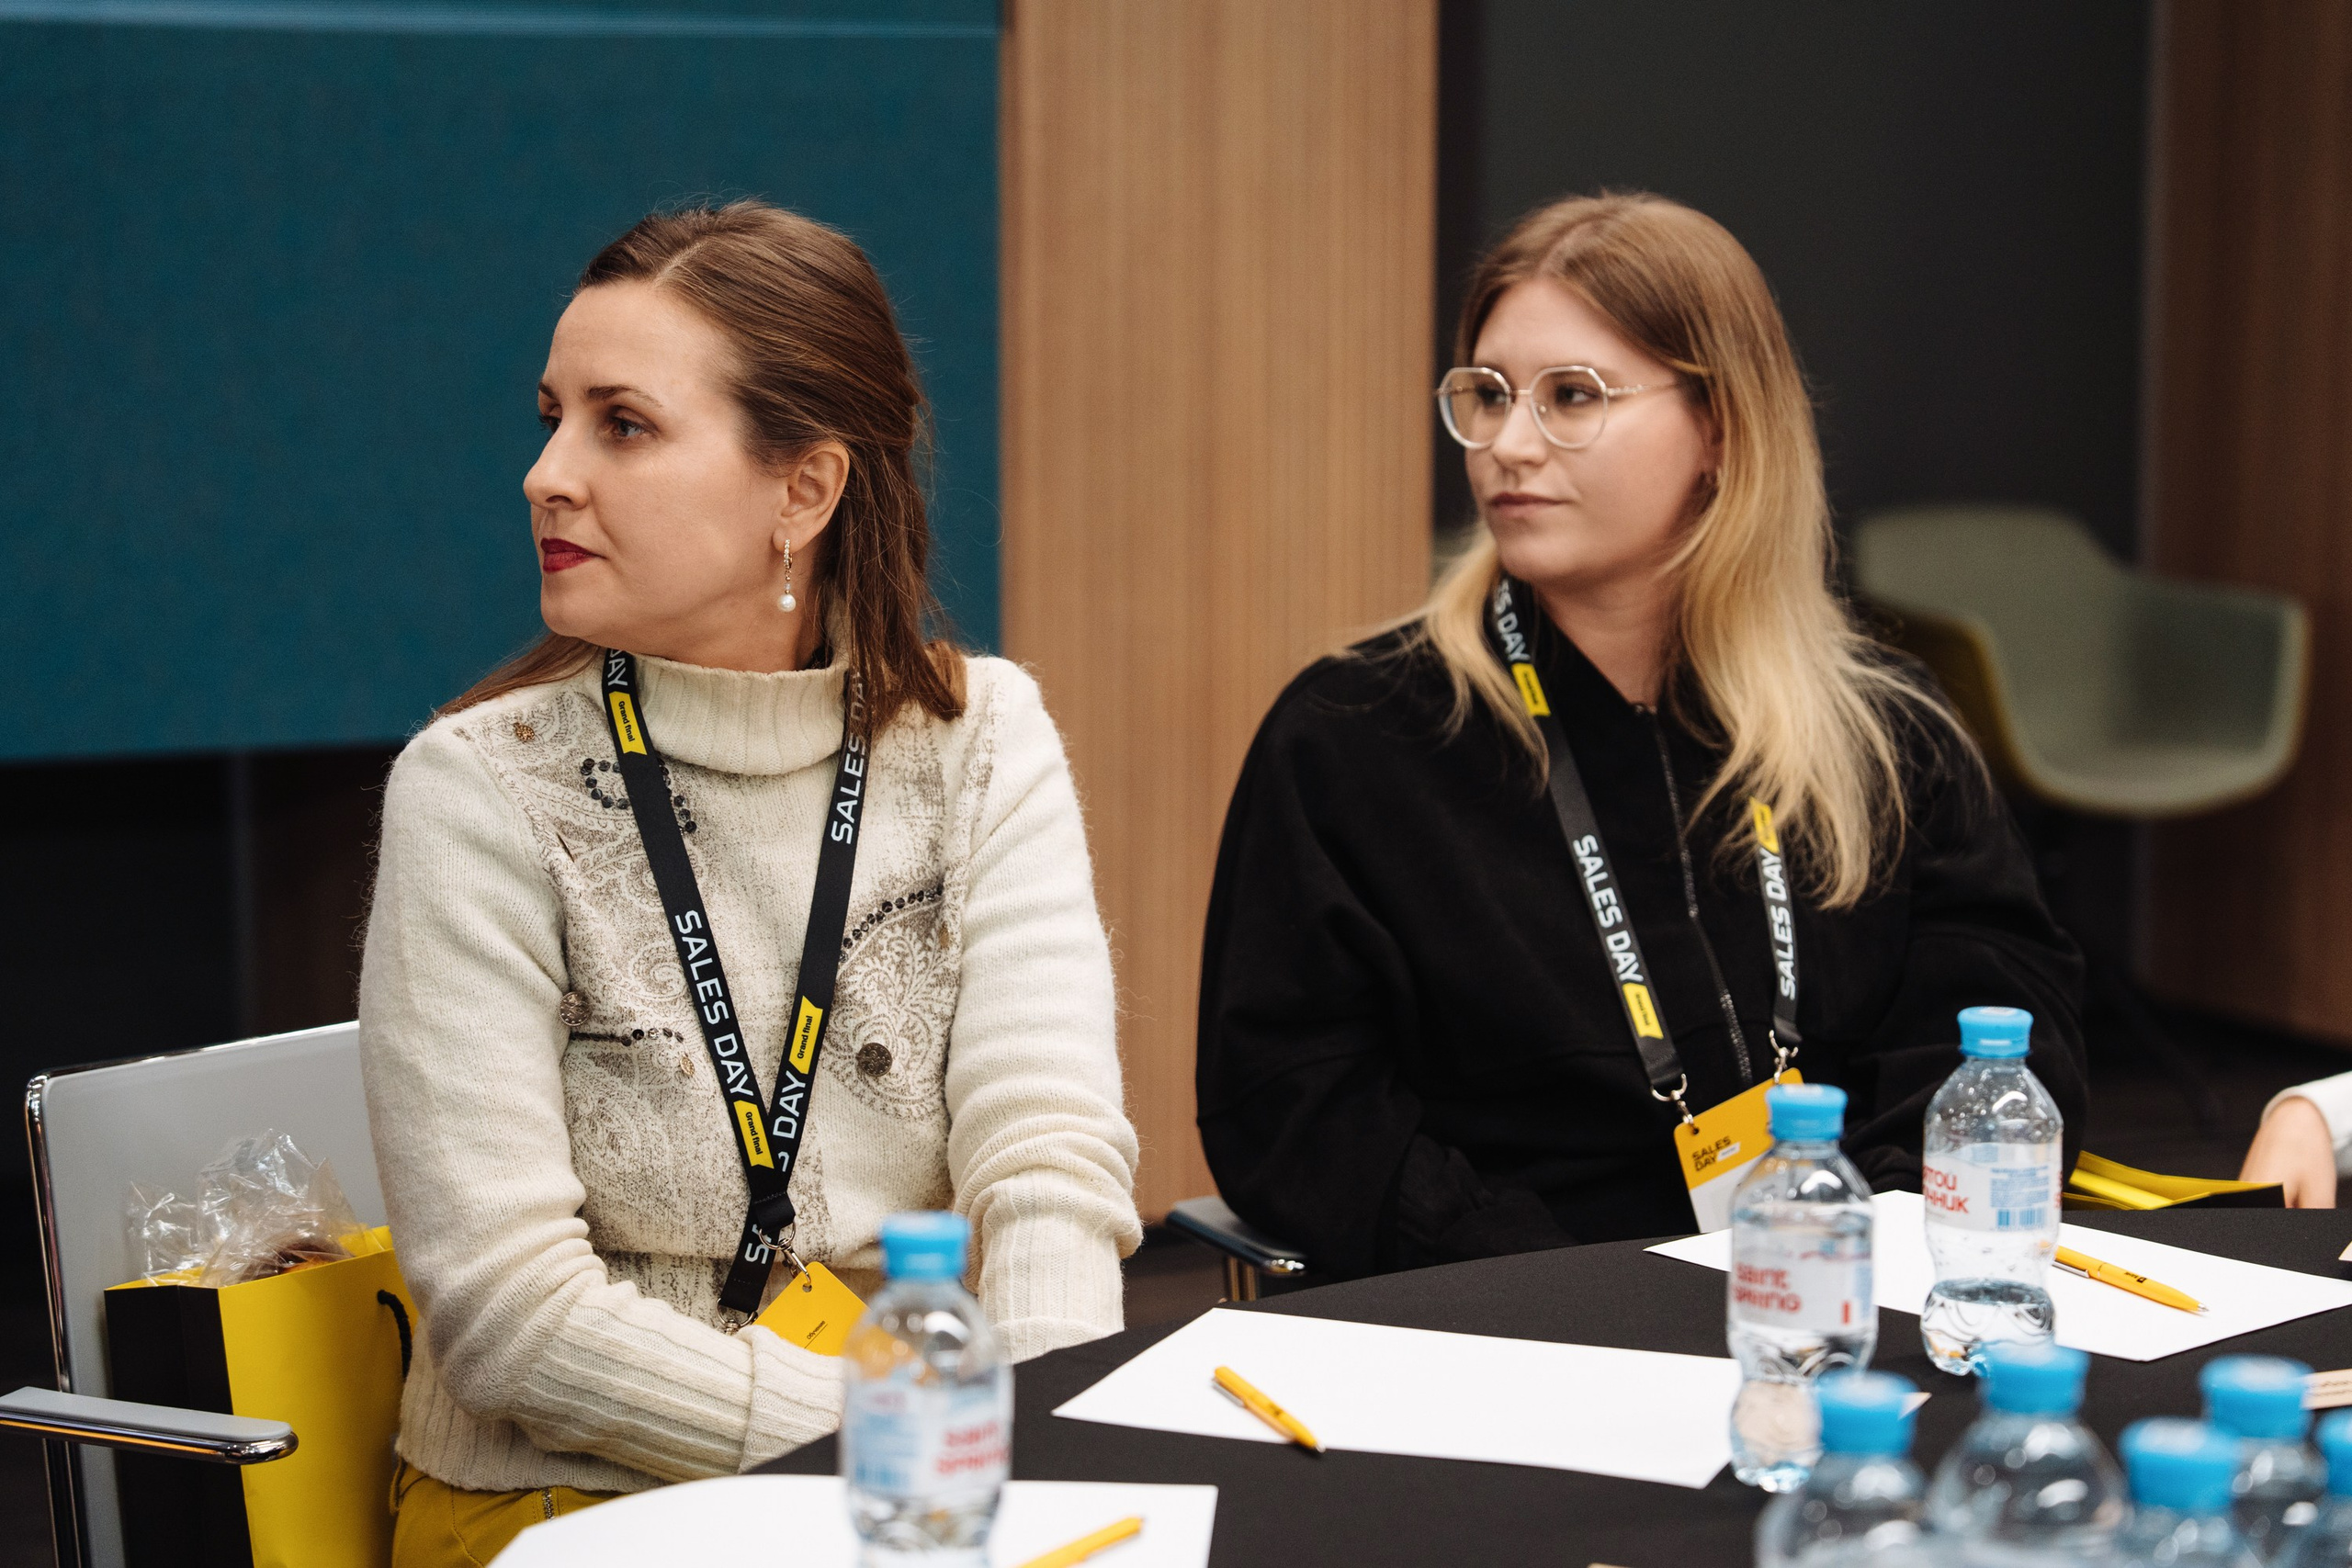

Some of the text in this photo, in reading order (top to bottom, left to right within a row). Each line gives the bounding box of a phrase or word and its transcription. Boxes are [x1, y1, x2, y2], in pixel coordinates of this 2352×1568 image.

[1498, 612, 1531, 660] DAY
[618, 700, 636, 742] Grand final
[1573, 834, 1644, 982] SALES DAY
[1758, 847, 1795, 1000] SALES DAY
[675, 909, 754, 1097] SALES DAY
[797, 1015, 813, 1059] Grand final
[773, 1070, 806, 1139] DAY
[745, 1111, 763, 1156] Grand final
[1691, 1135, 1732, 1160] SALES
[1695, 1153, 1717, 1171] DAY
